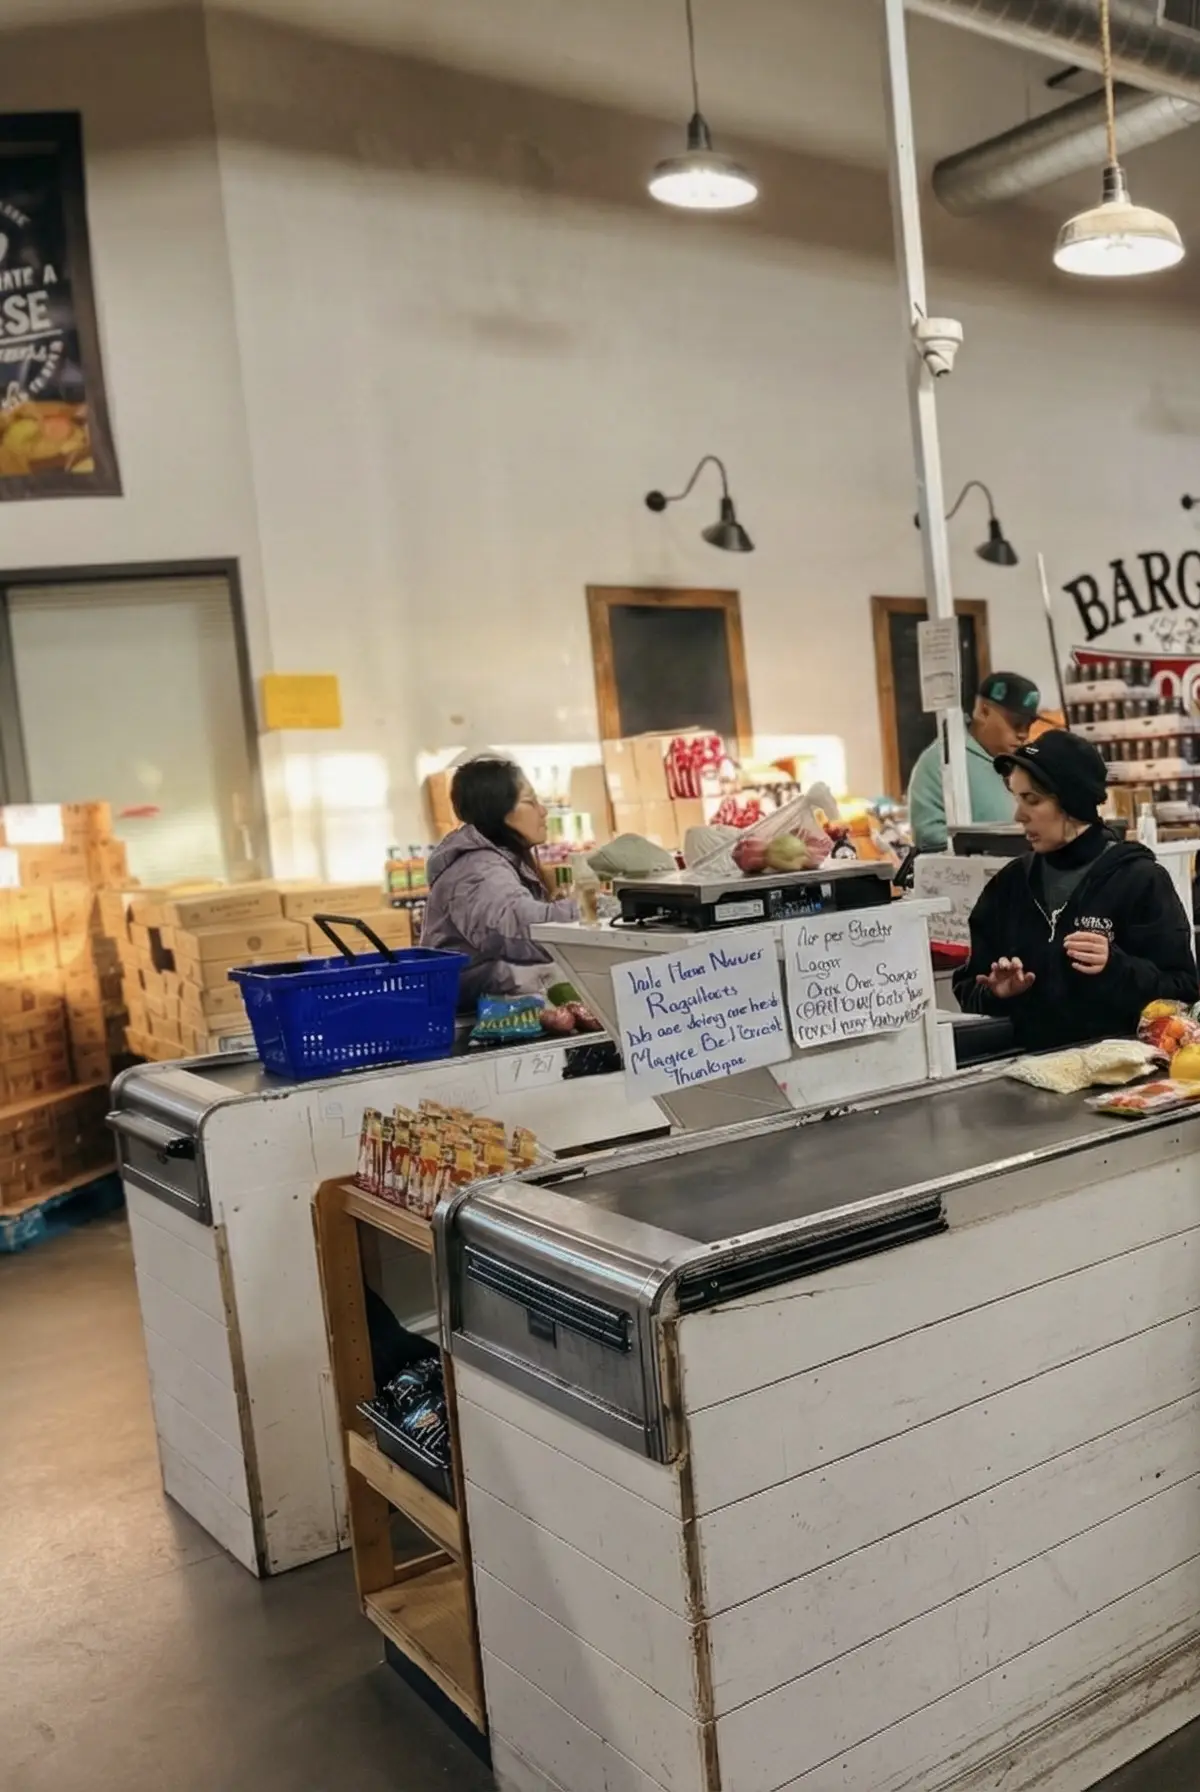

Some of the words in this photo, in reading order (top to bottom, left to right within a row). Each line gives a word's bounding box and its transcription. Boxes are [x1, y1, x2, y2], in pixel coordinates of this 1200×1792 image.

[0, 267, 33, 292] ATE
[43, 264, 58, 285] A
[0, 290, 51, 335] SE
